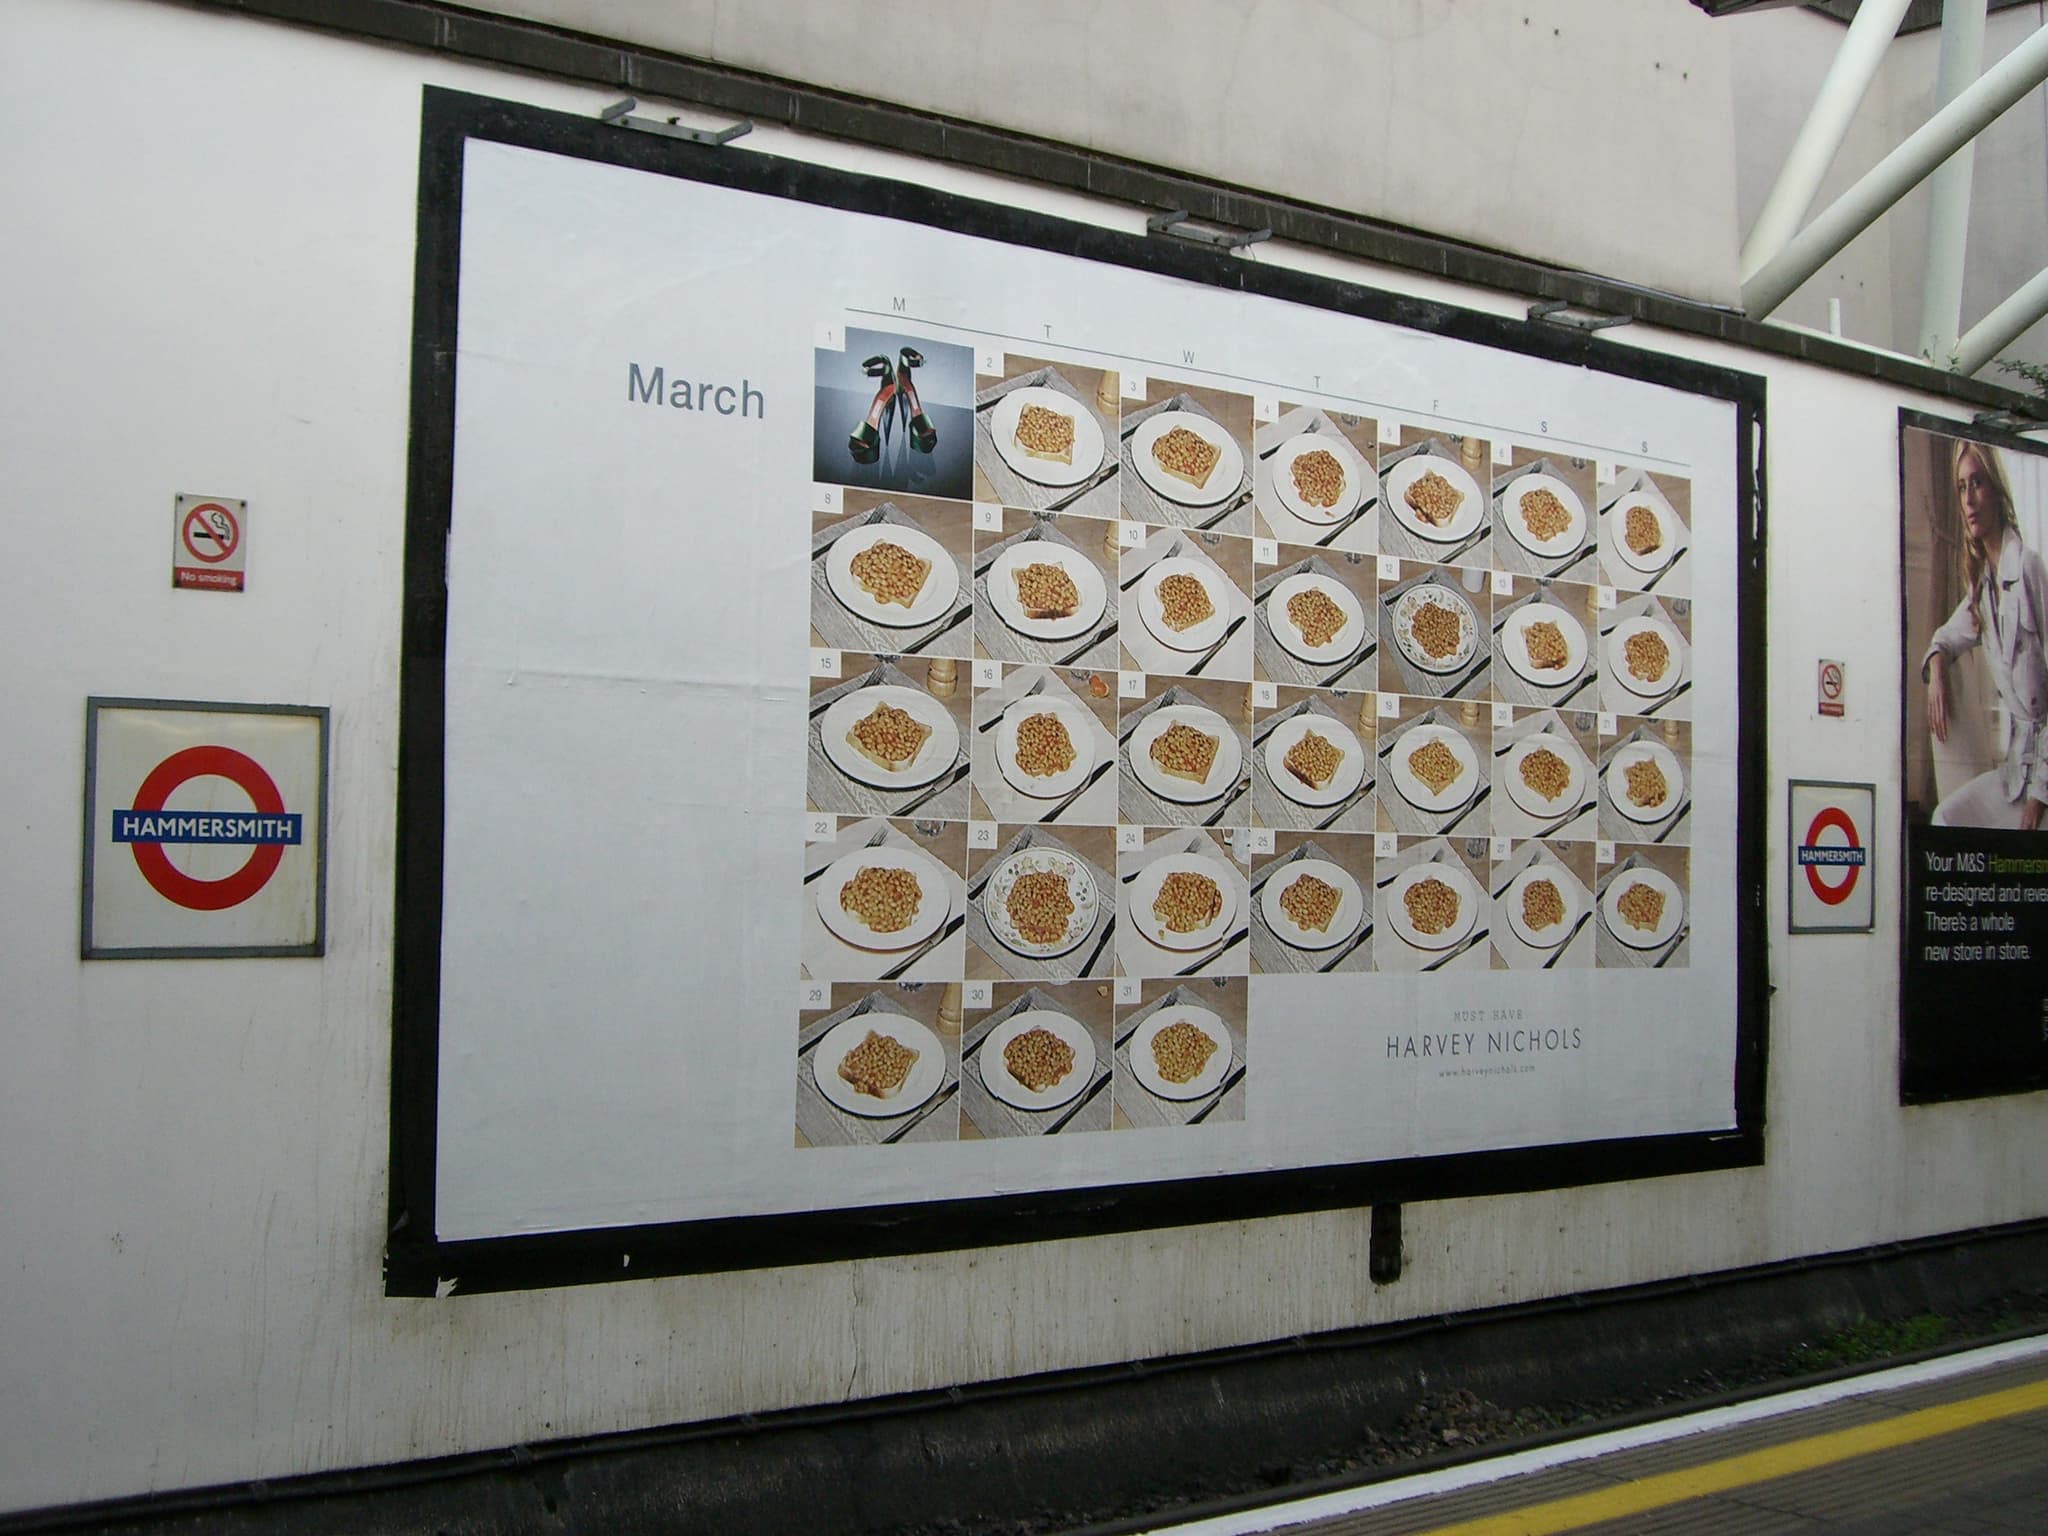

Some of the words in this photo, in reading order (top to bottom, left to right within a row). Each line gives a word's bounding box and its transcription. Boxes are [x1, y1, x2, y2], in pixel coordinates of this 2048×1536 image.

[827, 331, 832, 342] 1
[986, 357, 993, 369] 2
[1130, 381, 1137, 392] 3
[1264, 404, 1270, 414] 4
[893, 296, 905, 312] M
[1043, 324, 1051, 338] T
[1183, 350, 1195, 364] W
[1313, 375, 1321, 388] T
[1433, 399, 1440, 411] F
[1541, 420, 1548, 433] S
[1641, 440, 1648, 453] S
[628, 362, 764, 419] March
[825, 492, 832, 505] 8
[985, 512, 992, 522] 9
[1129, 530, 1138, 541] 10
[1262, 547, 1269, 557] 11
[180, 571, 197, 582] No
[198, 574, 238, 587] smoking
[821, 658, 832, 669] 15
[984, 669, 993, 679] 16
[1128, 680, 1137, 690] 17
[123, 816, 293, 839] HAMMERSMITH
[815, 822, 828, 833] 22
[978, 830, 990, 841] 23
[1125, 833, 1136, 844] 24
[1258, 836, 1268, 847] 25
[1801, 849, 1864, 863] HAMMERSMITH
[1926, 851, 1954, 872] Your
[1956, 852, 1985, 873] M&S
[1926, 882, 1996, 907] re-designed
[1999, 883, 2022, 902] and
[1925, 911, 1968, 932] There's
[1969, 916, 1978, 931] a
[1981, 912, 2015, 931] whole
[1925, 945, 1951, 960] new
[1953, 942, 1983, 961] store
[1985, 941, 1996, 960] in
[1999, 942, 2031, 960] store.
[809, 989, 822, 1001] 29
[972, 989, 984, 1001] 30
[1454, 1010, 1485, 1022] MUST
[1493, 1008, 1524, 1021] HAVE
[1387, 1032, 1475, 1058] HARVEY
[1488, 1027, 1582, 1053] NICHOLS
